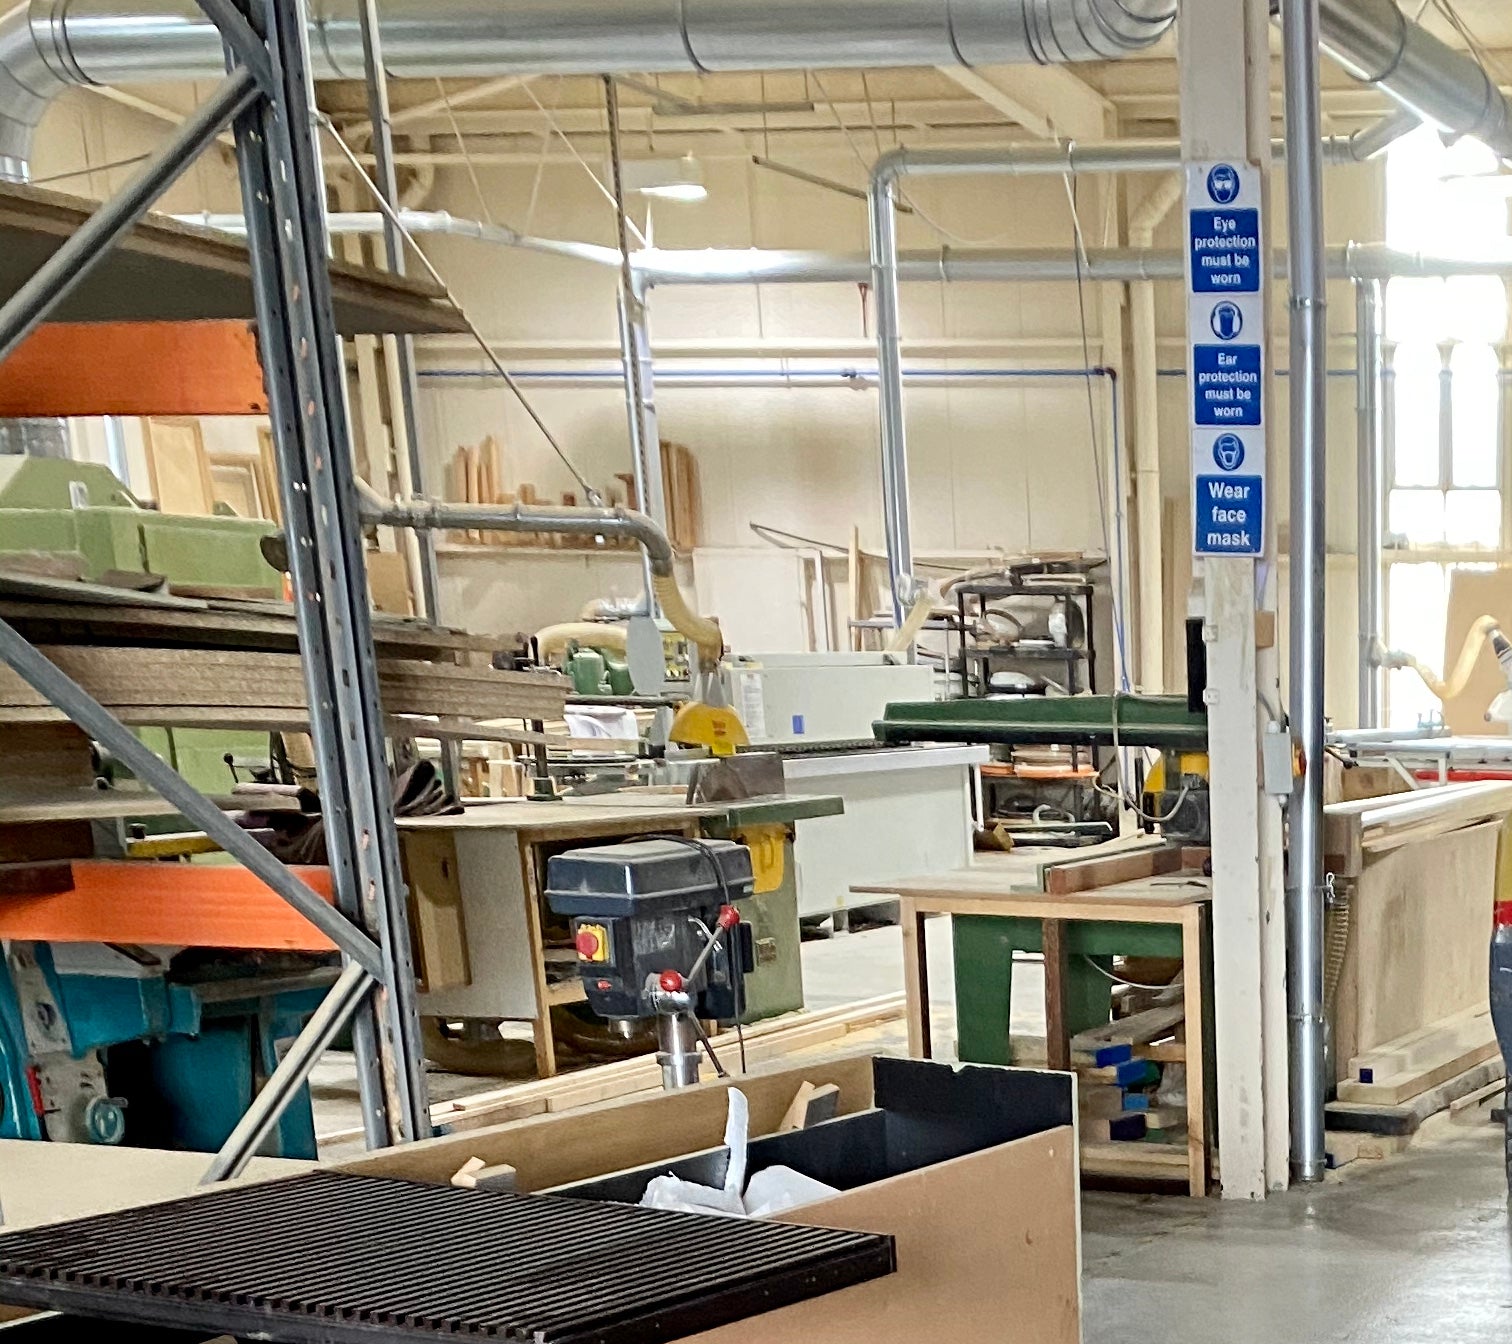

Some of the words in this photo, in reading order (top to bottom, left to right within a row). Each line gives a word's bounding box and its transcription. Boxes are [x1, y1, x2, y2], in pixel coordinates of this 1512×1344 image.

[1213, 216, 1236, 232] Eye
[1194, 235, 1256, 251] protection
[1201, 254, 1231, 267] must
[1234, 253, 1250, 267] be
[1210, 273, 1241, 285] worn
[1217, 352, 1237, 365] Ear
[1198, 370, 1257, 386] protection
[1205, 388, 1233, 400] must
[1236, 387, 1251, 400] be
[1213, 406, 1243, 417] worn
[1208, 481, 1250, 499] Wear
[1211, 506, 1246, 522] face
[1207, 530, 1250, 546] mask
